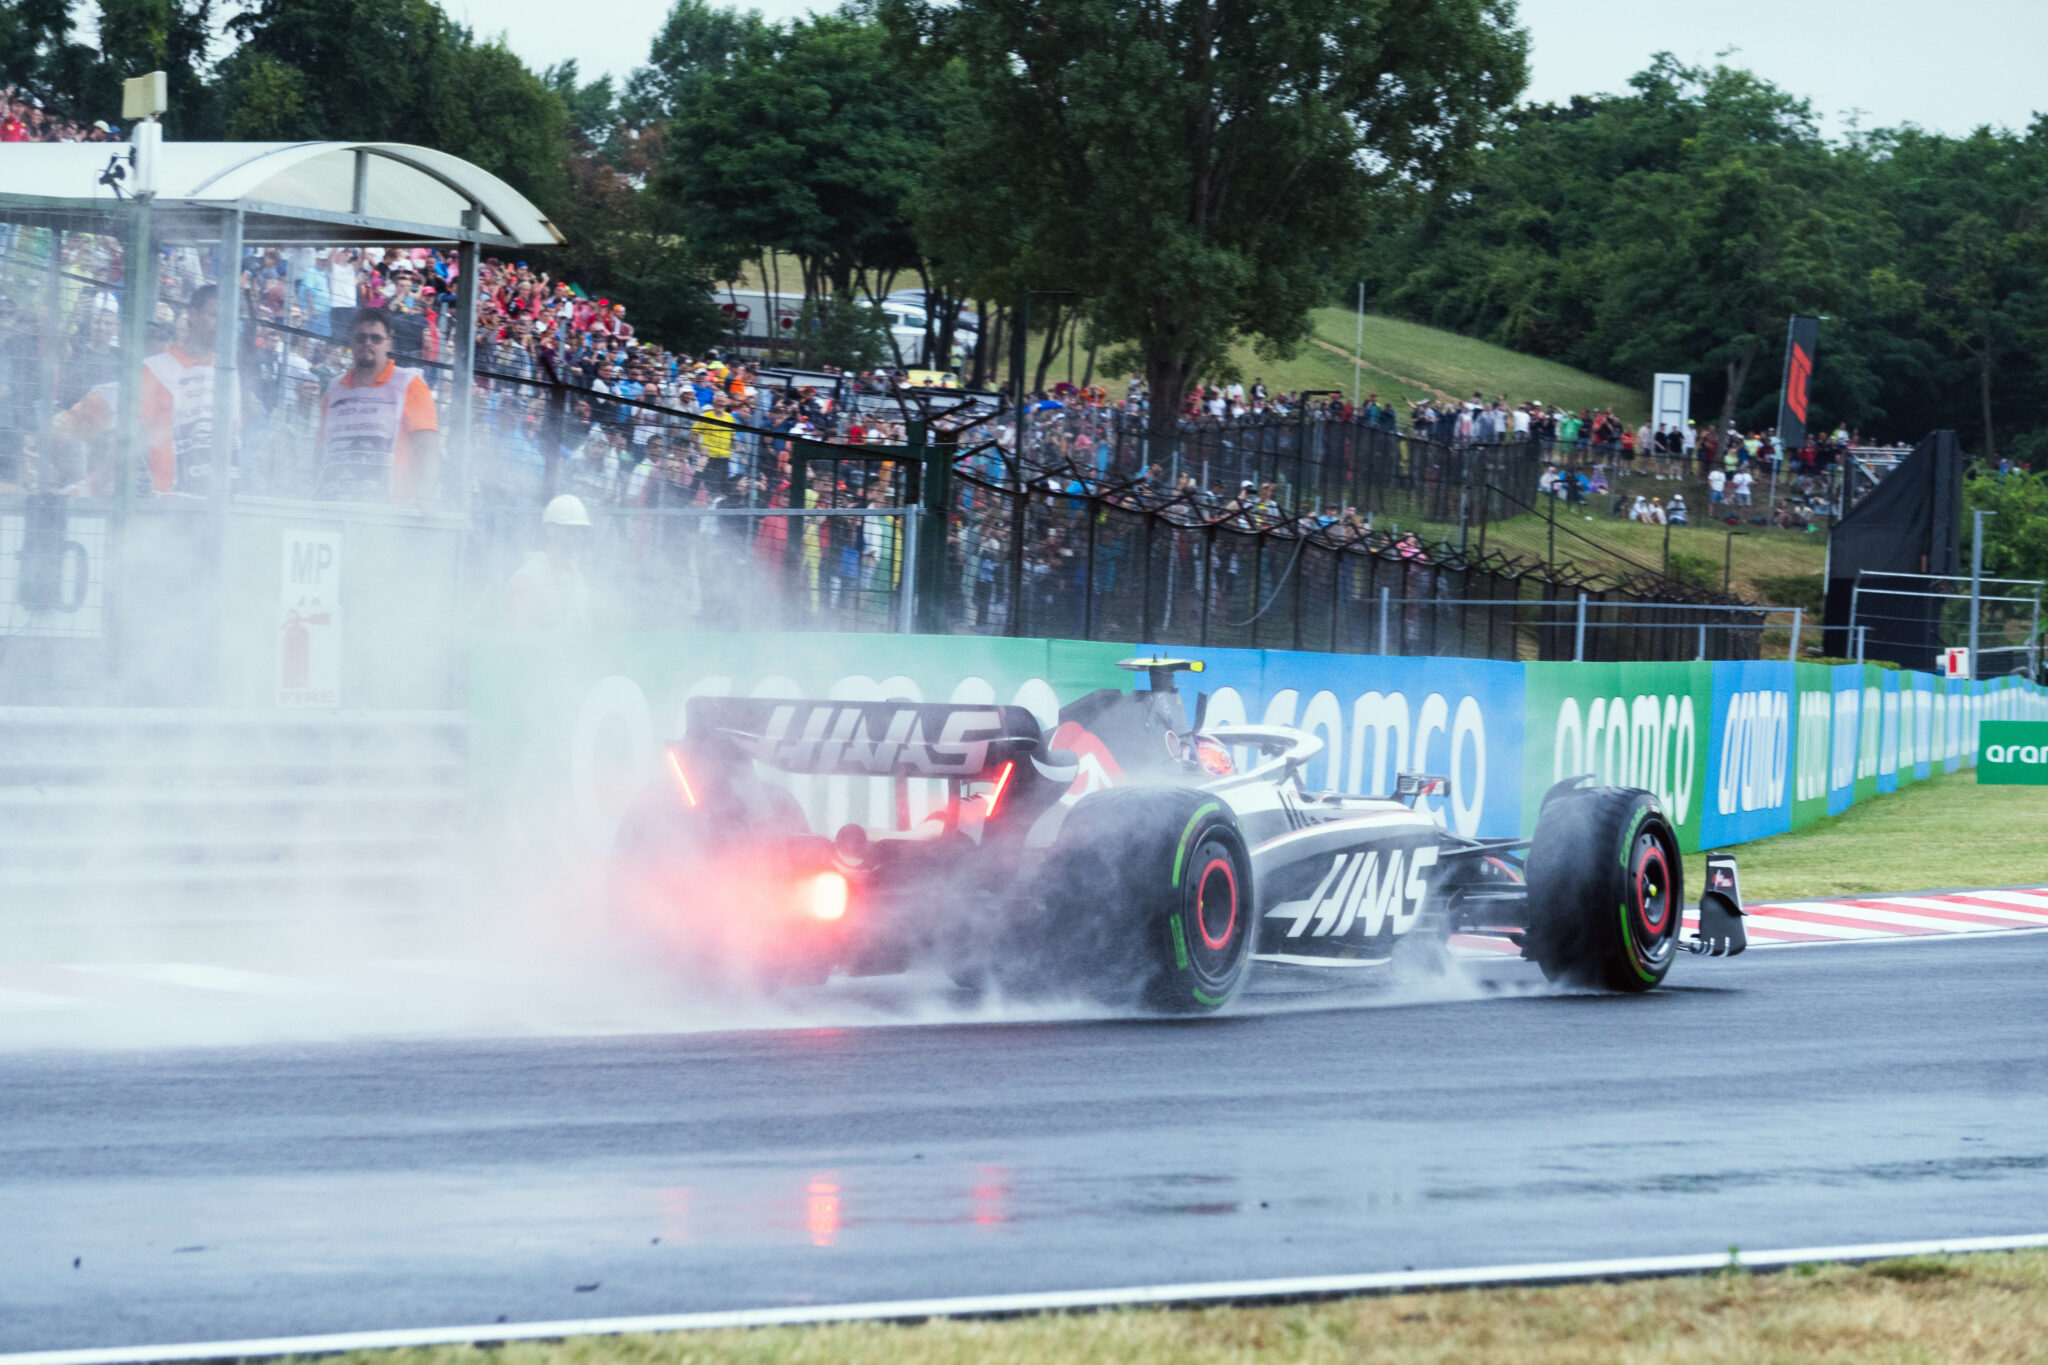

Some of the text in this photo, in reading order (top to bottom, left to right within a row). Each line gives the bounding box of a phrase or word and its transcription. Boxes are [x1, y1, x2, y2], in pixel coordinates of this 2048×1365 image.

[290, 541, 333, 585] MP
[280, 690, 336, 704] FIRE
[755, 705, 1001, 776] HAAS
[1985, 744, 2048, 764] ara
[1263, 846, 1440, 938] HAAS
